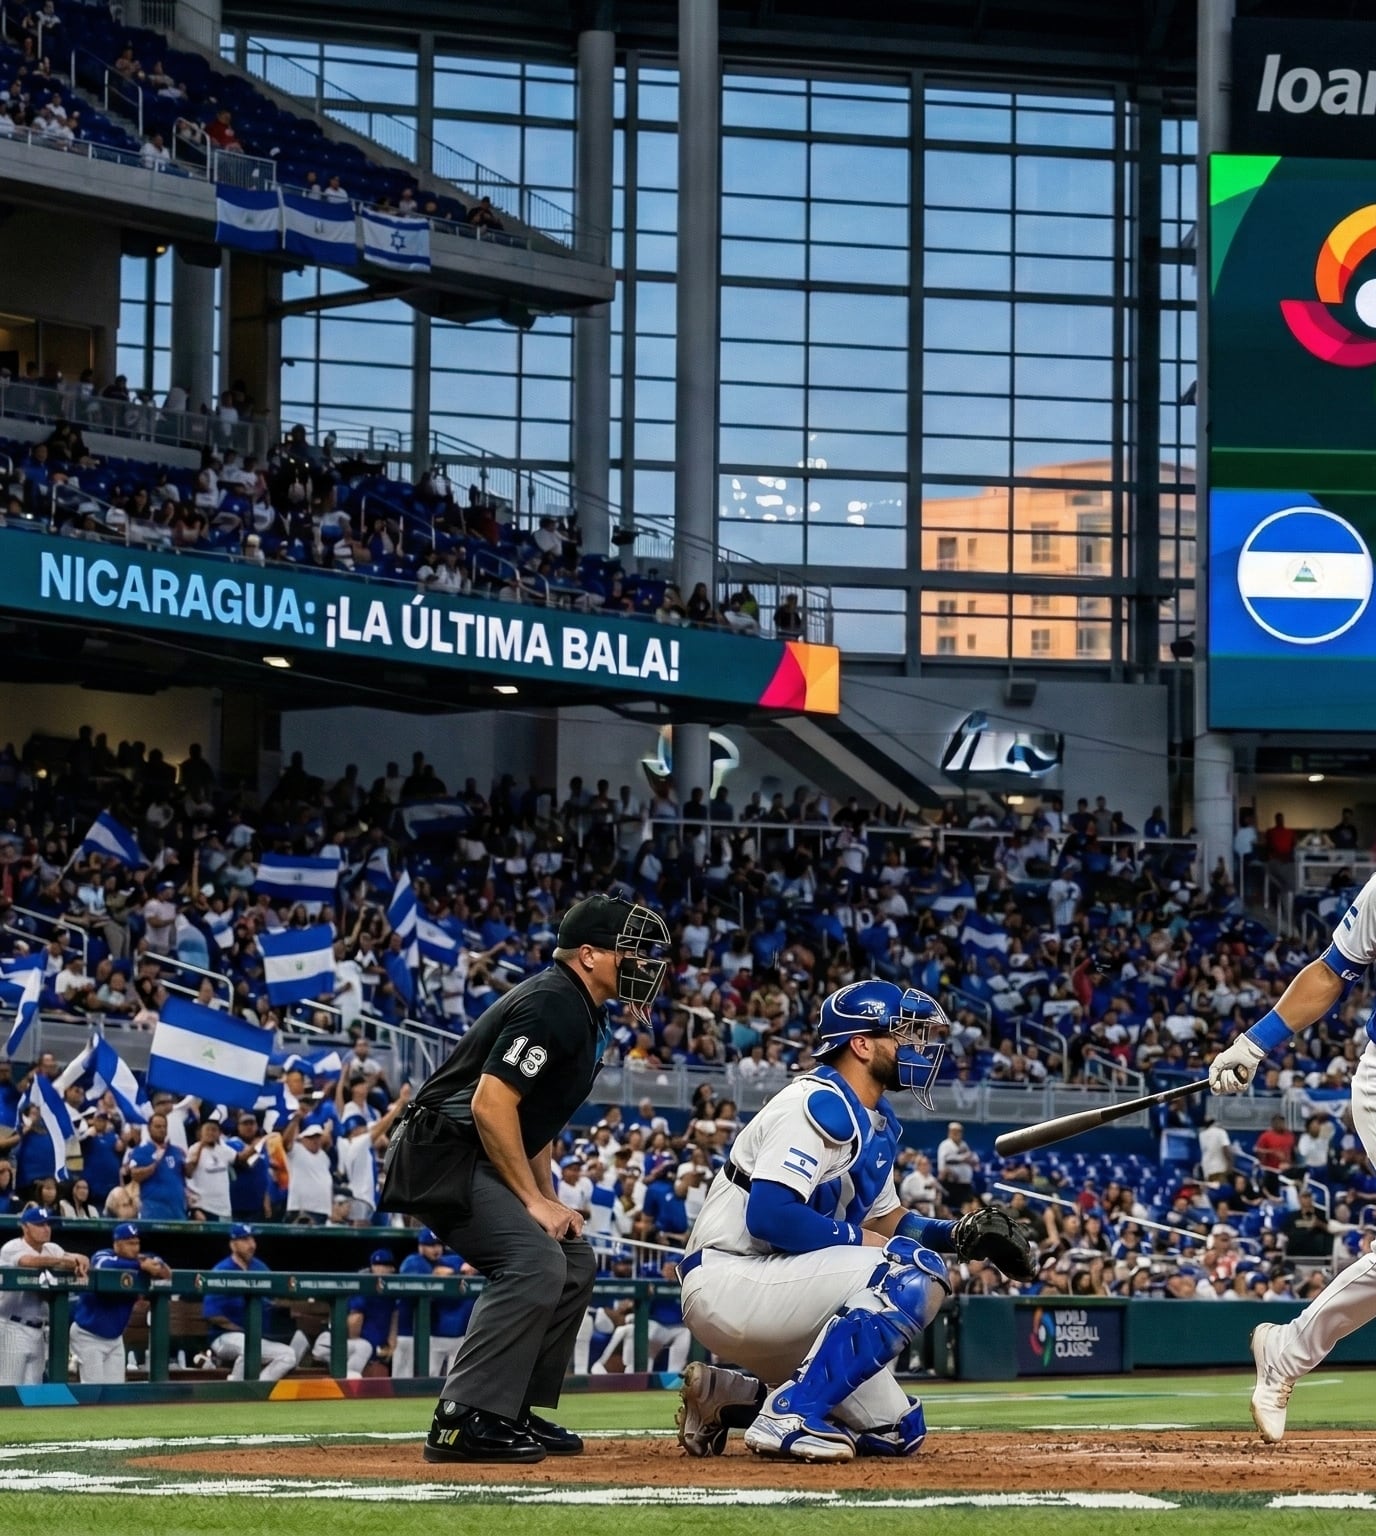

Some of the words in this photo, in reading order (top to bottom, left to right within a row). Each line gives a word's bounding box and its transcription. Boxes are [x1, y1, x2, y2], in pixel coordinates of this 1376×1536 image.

[40, 552, 315, 634] NICARAGUA:
[326, 596, 393, 648] ¡LA
[402, 594, 553, 666] ÚLTIMA
[562, 627, 680, 682] BALA!
